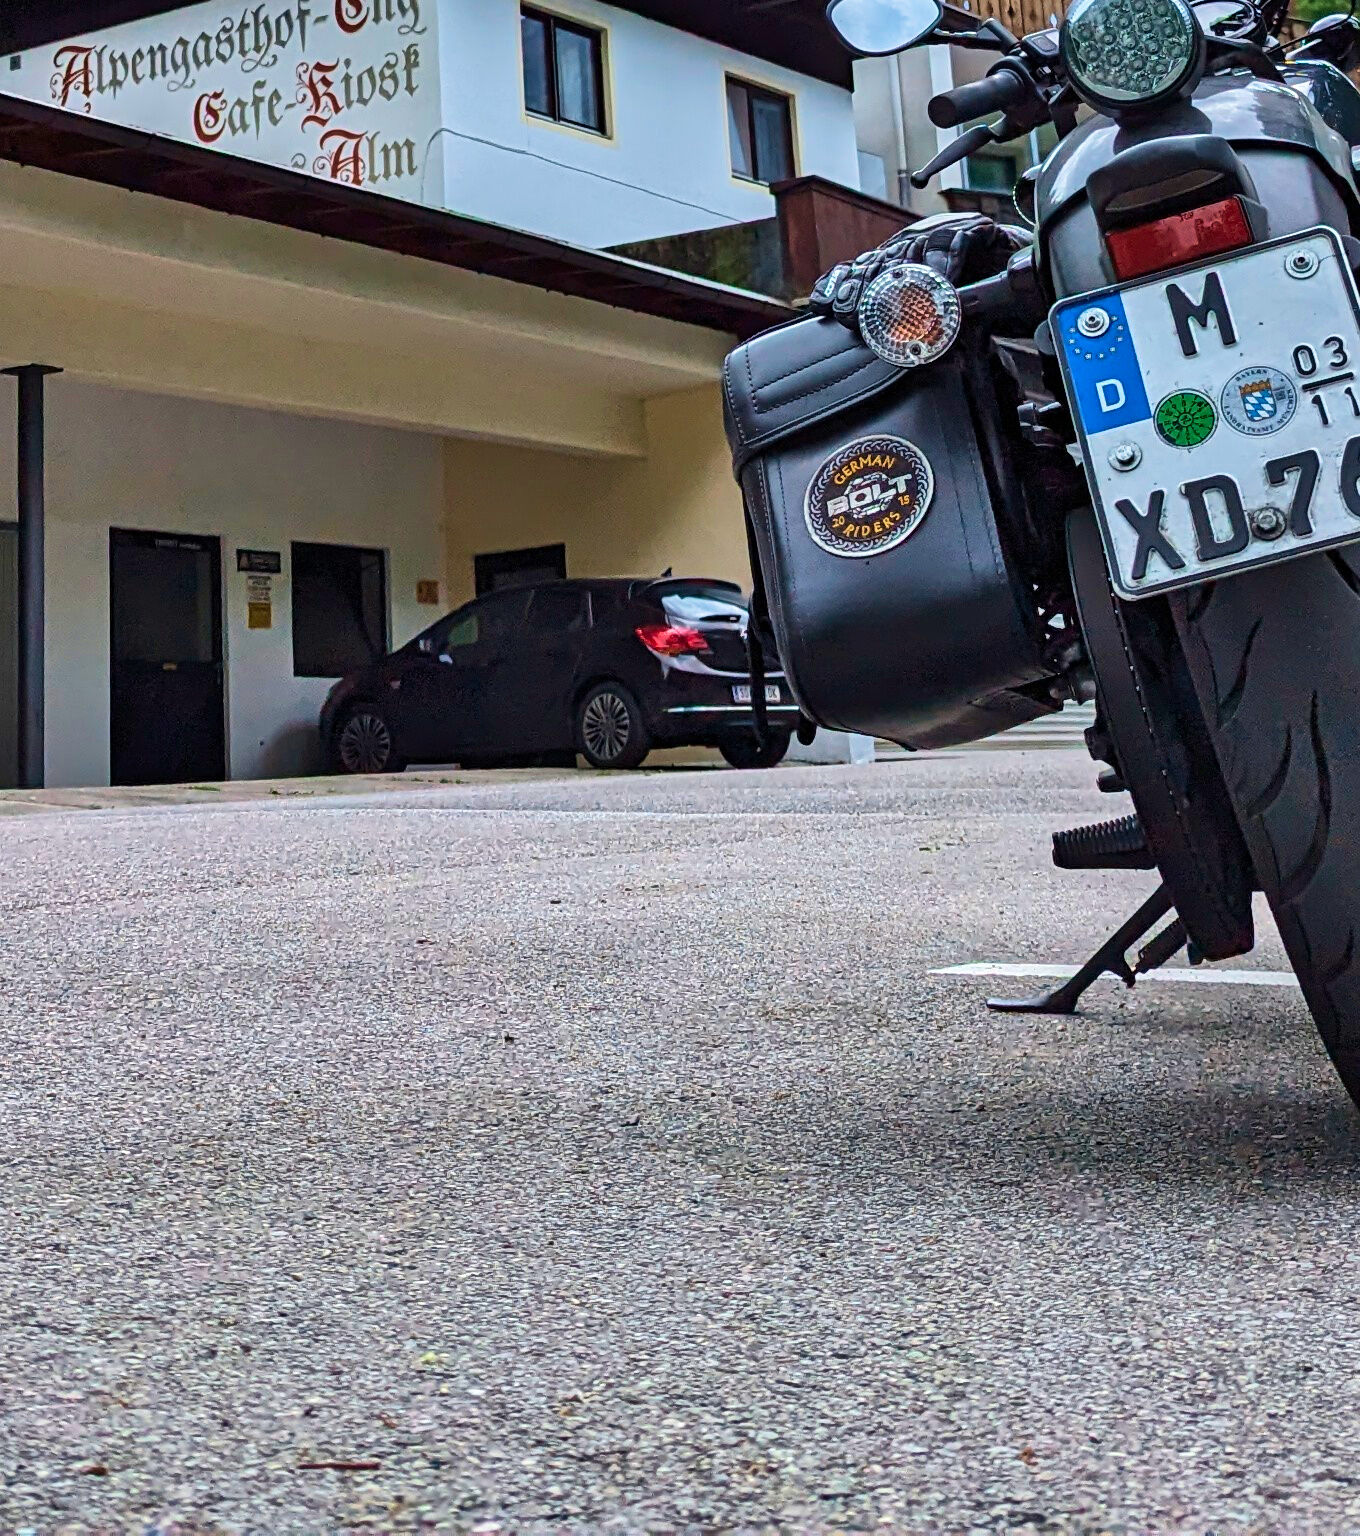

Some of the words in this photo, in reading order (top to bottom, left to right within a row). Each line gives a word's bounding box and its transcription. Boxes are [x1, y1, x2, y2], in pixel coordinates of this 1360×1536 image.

[315, 128, 417, 186] Alm
[1165, 271, 1238, 358] M
[1292, 335, 1349, 376] 03
[1096, 378, 1126, 413] D
[833, 453, 896, 485] GERMAN
[826, 473, 913, 517] BOLT
[831, 515, 845, 529] 20
[897, 494, 911, 507] 15
[843, 511, 902, 538] RIDERS
[1114, 474, 1251, 581] XD
